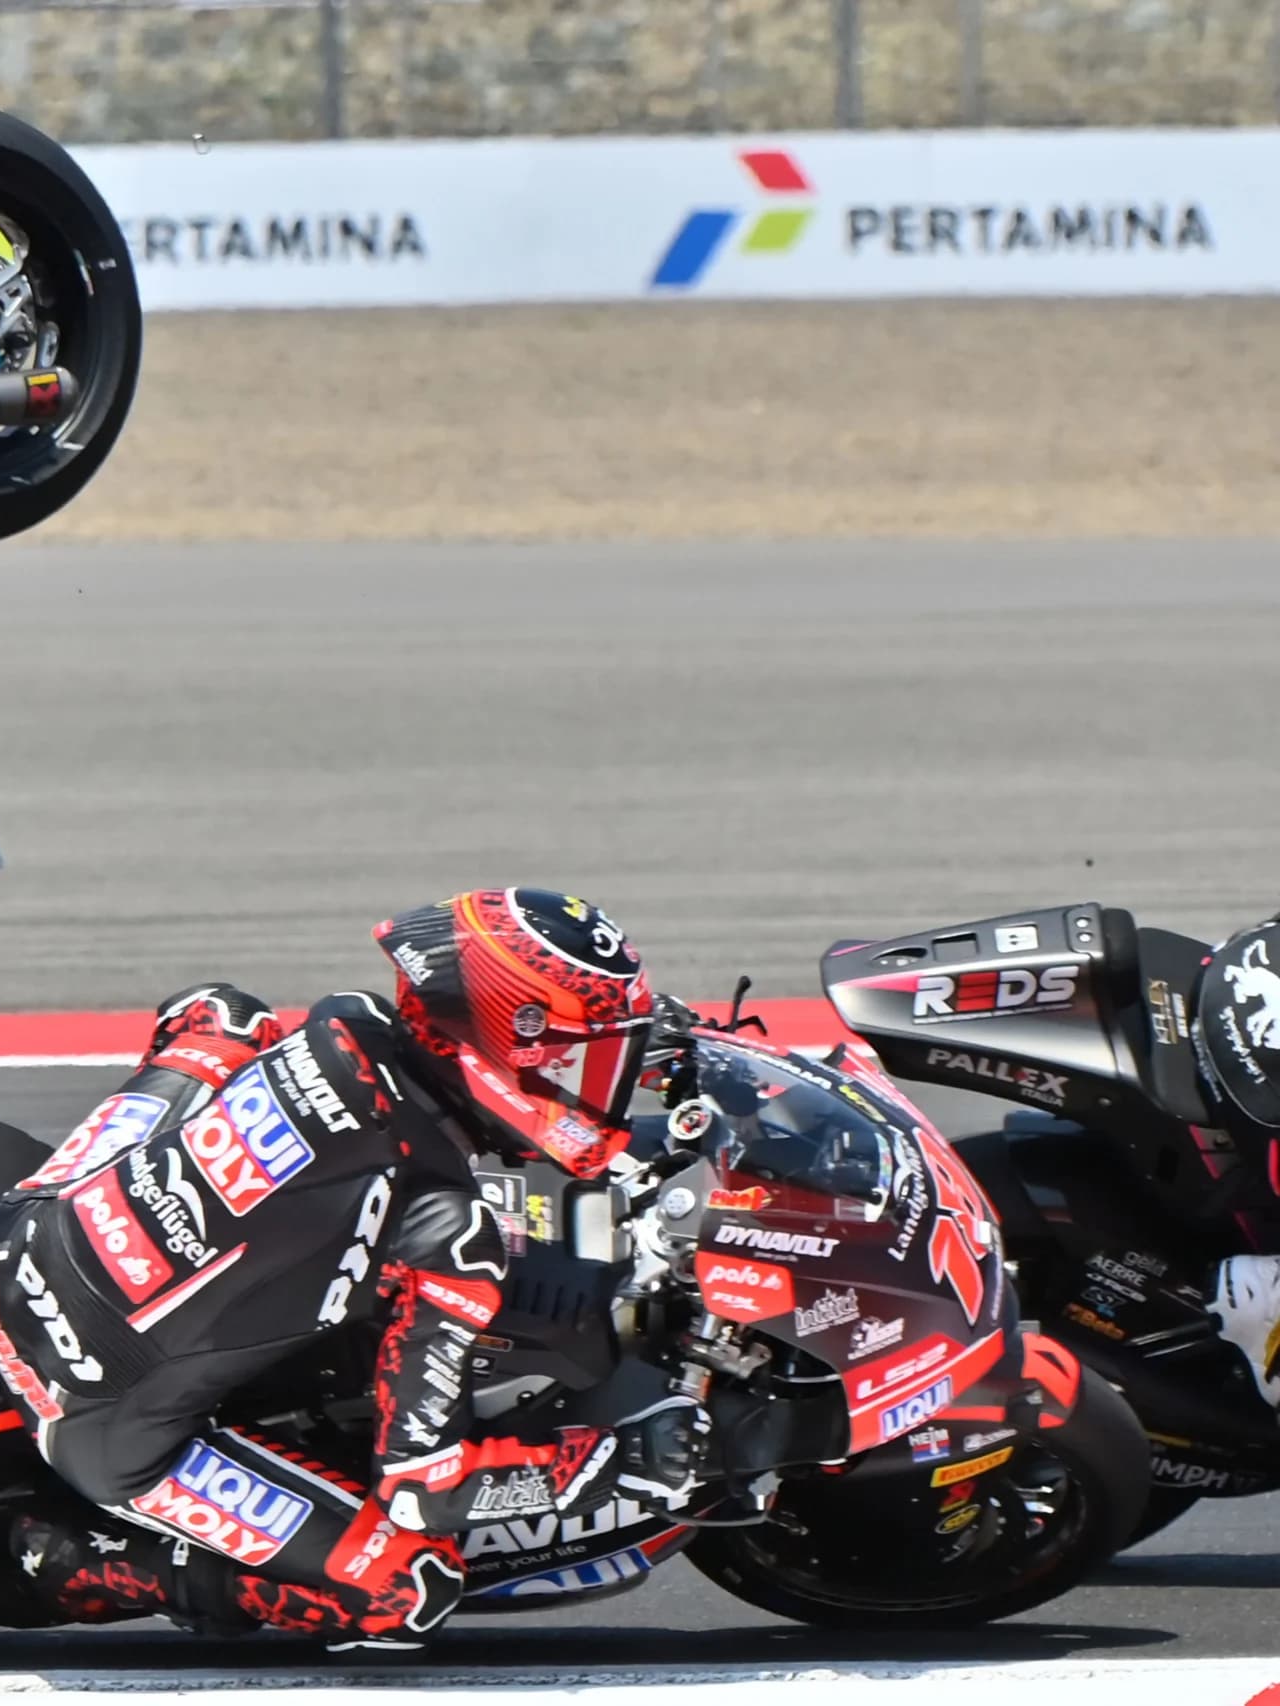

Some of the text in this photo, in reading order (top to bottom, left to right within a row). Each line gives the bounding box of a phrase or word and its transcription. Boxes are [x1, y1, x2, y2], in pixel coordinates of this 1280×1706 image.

[846, 204, 1214, 254] PERTAMINA
[914, 964, 1080, 1018] REDS
[283, 1029, 361, 1133] YNAVOLT
[927, 1047, 1071, 1098] PALLEX
[74, 1186, 129, 1256] polo
[714, 1225, 840, 1258] DYNAVOLT
[704, 1265, 762, 1287] polo
[1089, 1255, 1148, 1288] AERRE
[856, 1342, 949, 1400] LS2
[884, 1378, 952, 1438] LIQUI
[176, 1444, 310, 1539] LIQUI
[143, 1491, 282, 1564] MOLY
[508, 1550, 554, 1570] your
[556, 1543, 588, 1562] life
